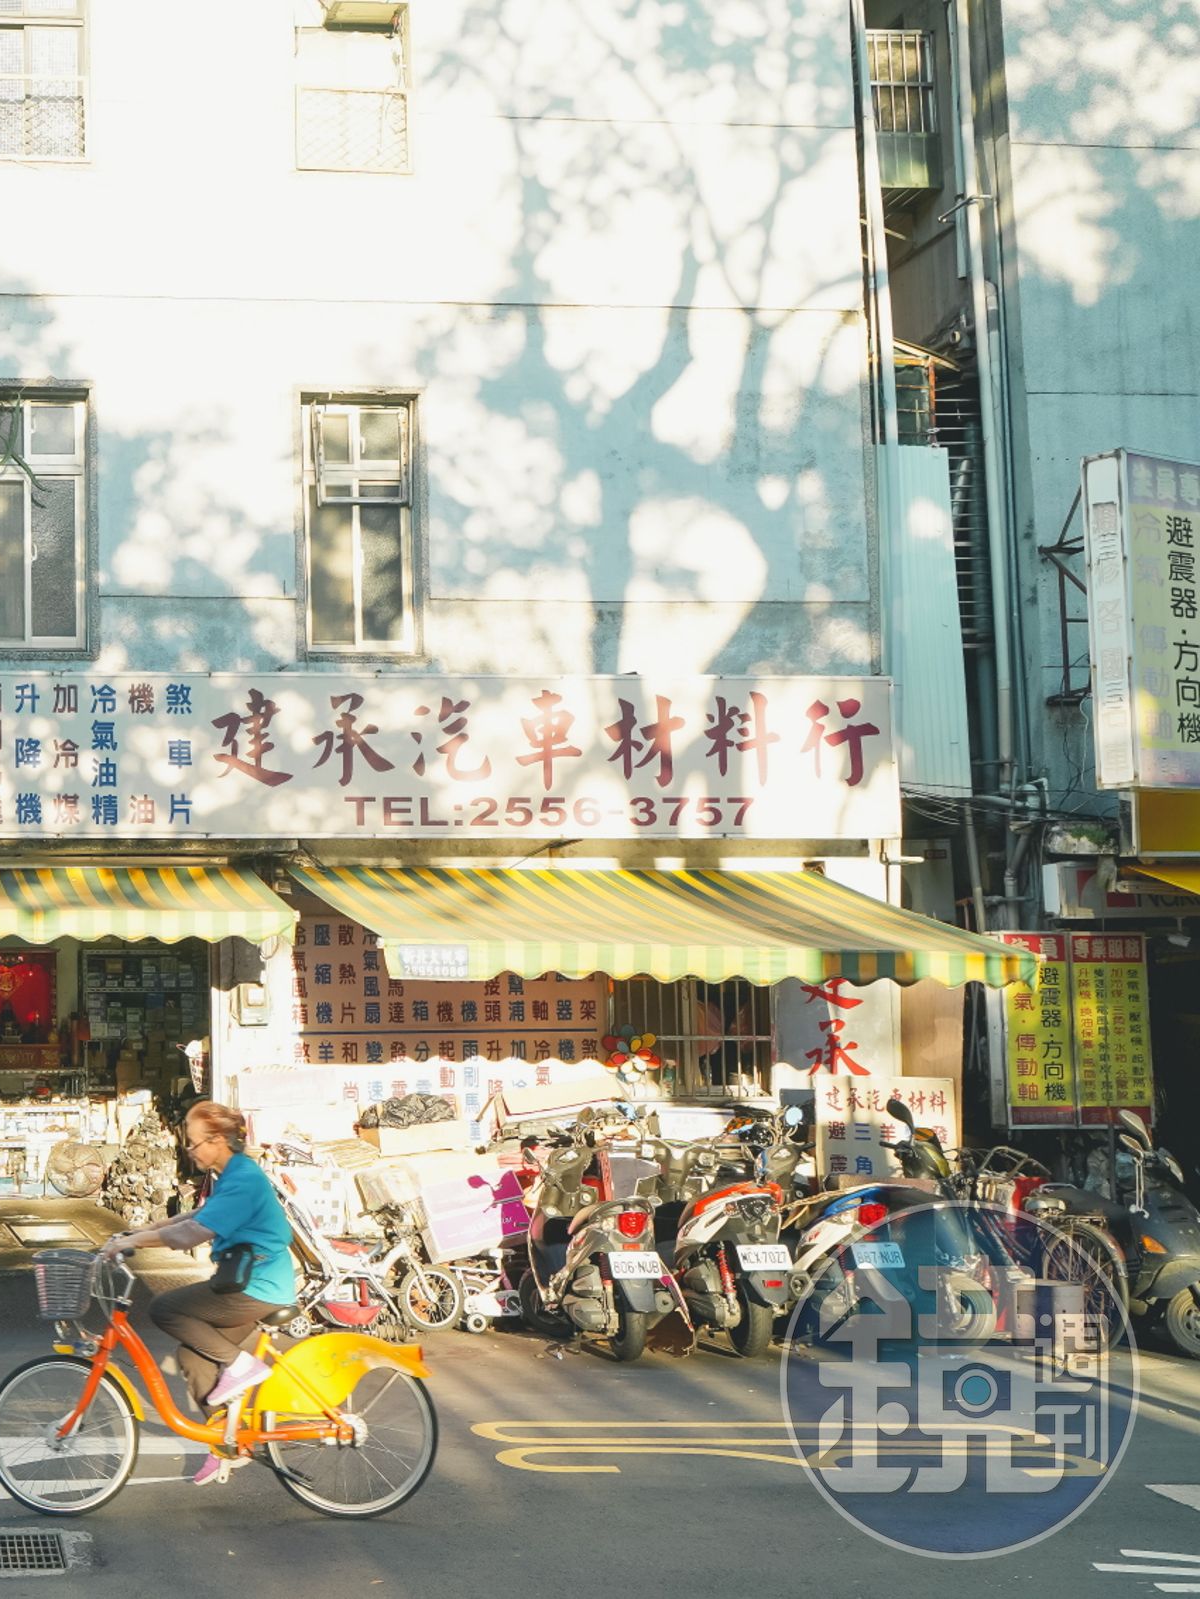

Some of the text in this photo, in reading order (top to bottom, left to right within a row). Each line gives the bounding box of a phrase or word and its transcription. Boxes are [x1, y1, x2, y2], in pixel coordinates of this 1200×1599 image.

[14, 683, 43, 826] 升降機
[52, 683, 81, 826] 加冷煤
[90, 684, 119, 827] 冷氣油精
[127, 683, 156, 827] 機油
[164, 683, 194, 826] 煞車片
[210, 687, 880, 792] 建承汽車材料行
[344, 796, 755, 828] TEL:2556-3757
[314, 924, 333, 1024] 壓縮機
[338, 924, 357, 1024] 散熱片
